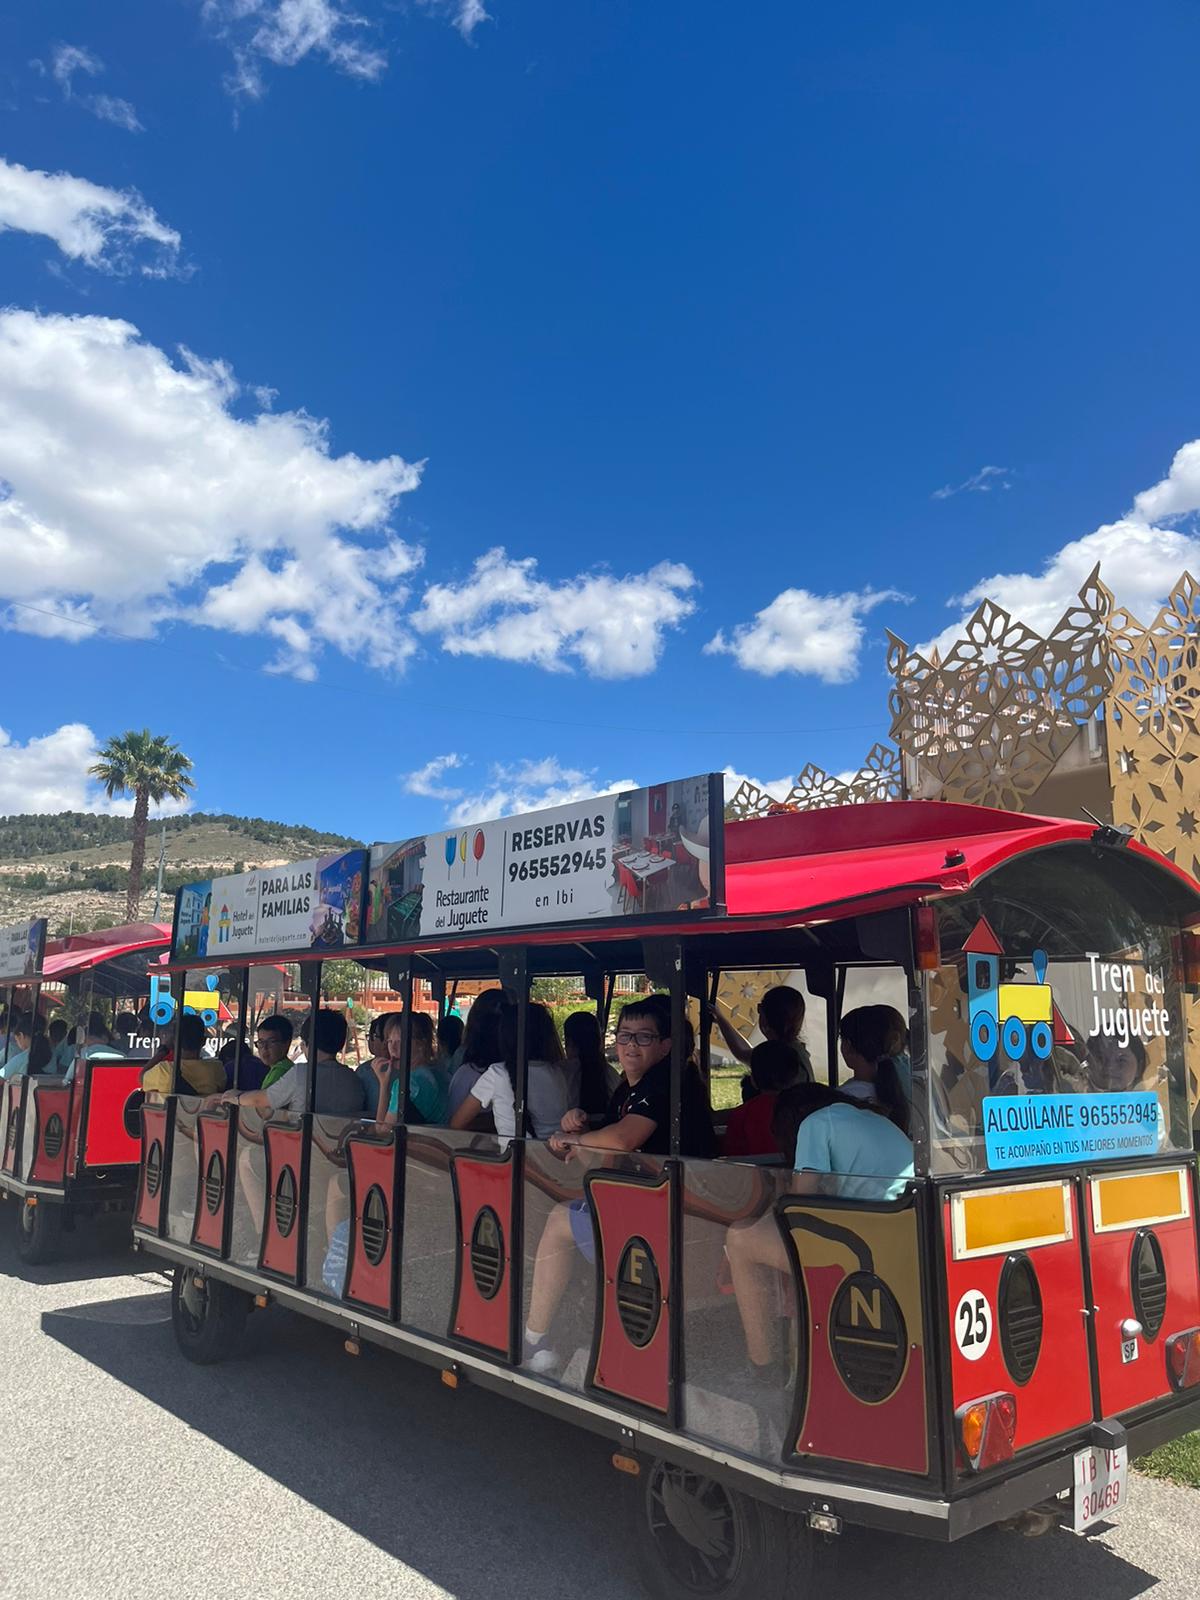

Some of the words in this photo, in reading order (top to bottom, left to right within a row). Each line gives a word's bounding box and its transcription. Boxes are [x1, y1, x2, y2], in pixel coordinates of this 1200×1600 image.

[512, 815, 605, 852] RESERVAS
[509, 848, 606, 882] 965552945
[262, 877, 289, 896] PARA
[292, 872, 311, 890] LAS
[436, 885, 489, 907] Restaurante
[262, 896, 310, 918] FAMILIAS
[535, 895, 549, 907] en
[556, 888, 574, 905] Ibi
[233, 910, 248, 921] Hotel
[435, 916, 445, 928] del
[447, 907, 488, 930] Juguete
[232, 926, 254, 940] Juguete
[1085, 952, 1135, 993] Tren
[1145, 966, 1165, 994] del
[1089, 996, 1170, 1048] Juguete
[127, 1033, 160, 1049] Tren
[988, 1099, 1074, 1133] ALQUÍLAME
[1080, 1102, 1157, 1127] 965552945
[995, 1146, 1006, 1160] TE
[1008, 1140, 1051, 1159] ACOMPAÑO
[1053, 1142, 1063, 1155] EN
[1065, 1140, 1080, 1153] TUS
[1081, 1137, 1115, 1152] MEJORES
[1117, 1134, 1154, 1149] MOMENTOS
[630, 1249, 647, 1285] E
[850, 1286, 881, 1329] N
[960, 1298, 987, 1347] 25
[1124, 1342, 1135, 1359] SP
[1083, 1480, 1120, 1520] 30469
